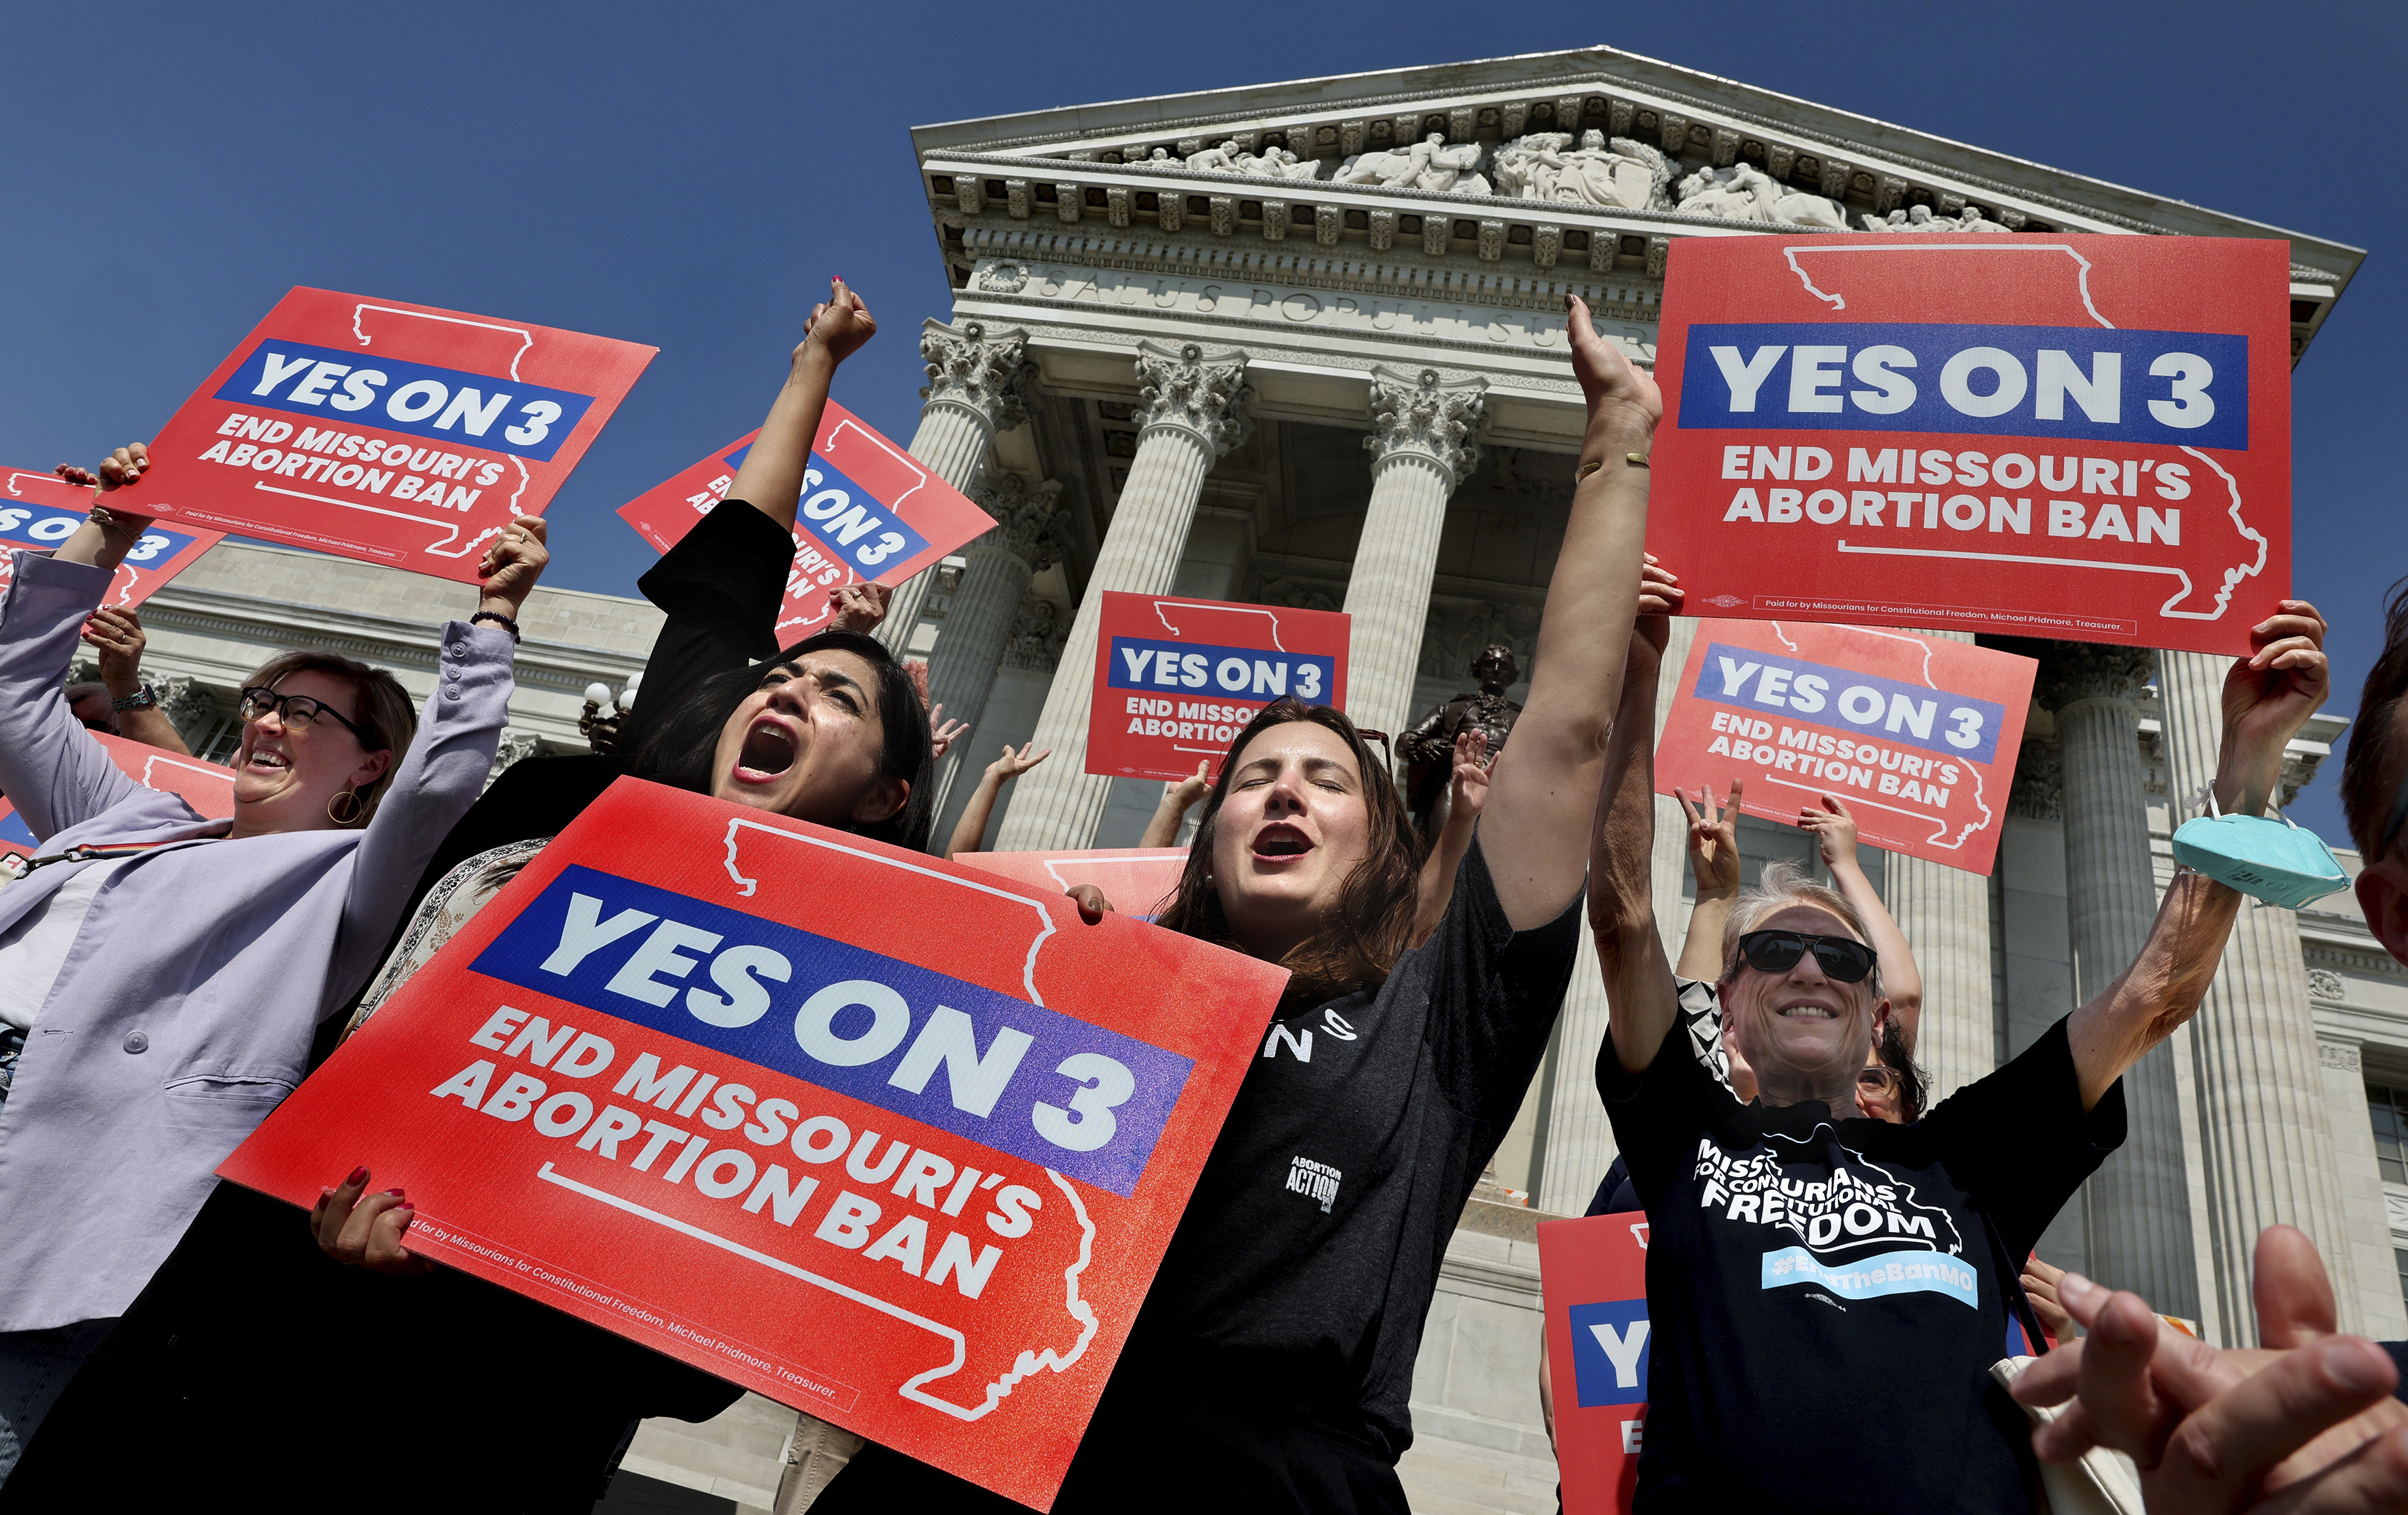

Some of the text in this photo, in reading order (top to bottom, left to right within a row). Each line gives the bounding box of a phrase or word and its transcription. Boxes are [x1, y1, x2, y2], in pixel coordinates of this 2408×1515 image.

[1040, 270, 1221, 312] SALUS
[1244, 288, 1464, 338] POPULI
[252, 353, 561, 445] YES ON 3
[1709, 345, 2214, 428] YES ON 3
[198, 439, 482, 512] ABORTION BAN
[217, 413, 504, 486] END MISSOURI'S
[1722, 446, 2190, 500] END MISSOURI'S
[707, 474, 733, 499] EN
[1723, 488, 2179, 546] ABORTION BAN
[28, 517, 81, 540] O
[185, 510, 199, 518] Paid
[206, 513, 214, 522] by
[214, 516, 246, 527] Missourians
[254, 524, 293, 536] Constitutional
[293, 532, 318, 542] Freedom,
[318, 536, 341, 546] Michael
[341, 541, 368, 552] Pridmore,
[369, 547, 397, 558] Treasurer.
[804, 490, 905, 565] ON 3
[786, 569, 816, 599] AN
[1766, 599, 2124, 631] Paid for by Missourians for Constitutional Freedom, Michael Pridmore, Treasurer.
[1122, 648, 1320, 698] YES ON 3
[1719, 656, 1983, 748] YES ON 3
[1126, 698, 1261, 724] END MISSO
[1708, 736, 1949, 808] ABORTION BAN
[1711, 712, 1959, 785] END MISSOURI'S
[1782, 812, 1799, 820] Constit
[540, 892, 1135, 1152] YES ON 3
[470, 1005, 1041, 1238] END MISSOURI'S
[429, 1059, 1003, 1300] ABORTION BAN
[1292, 1156, 1342, 1181] ABORTION
[1694, 1162, 1726, 1186] FOR
[418, 1221, 836, 1399] for by Missourians for Constitutional Freedom, Michael Pridmore, Treasurer.
